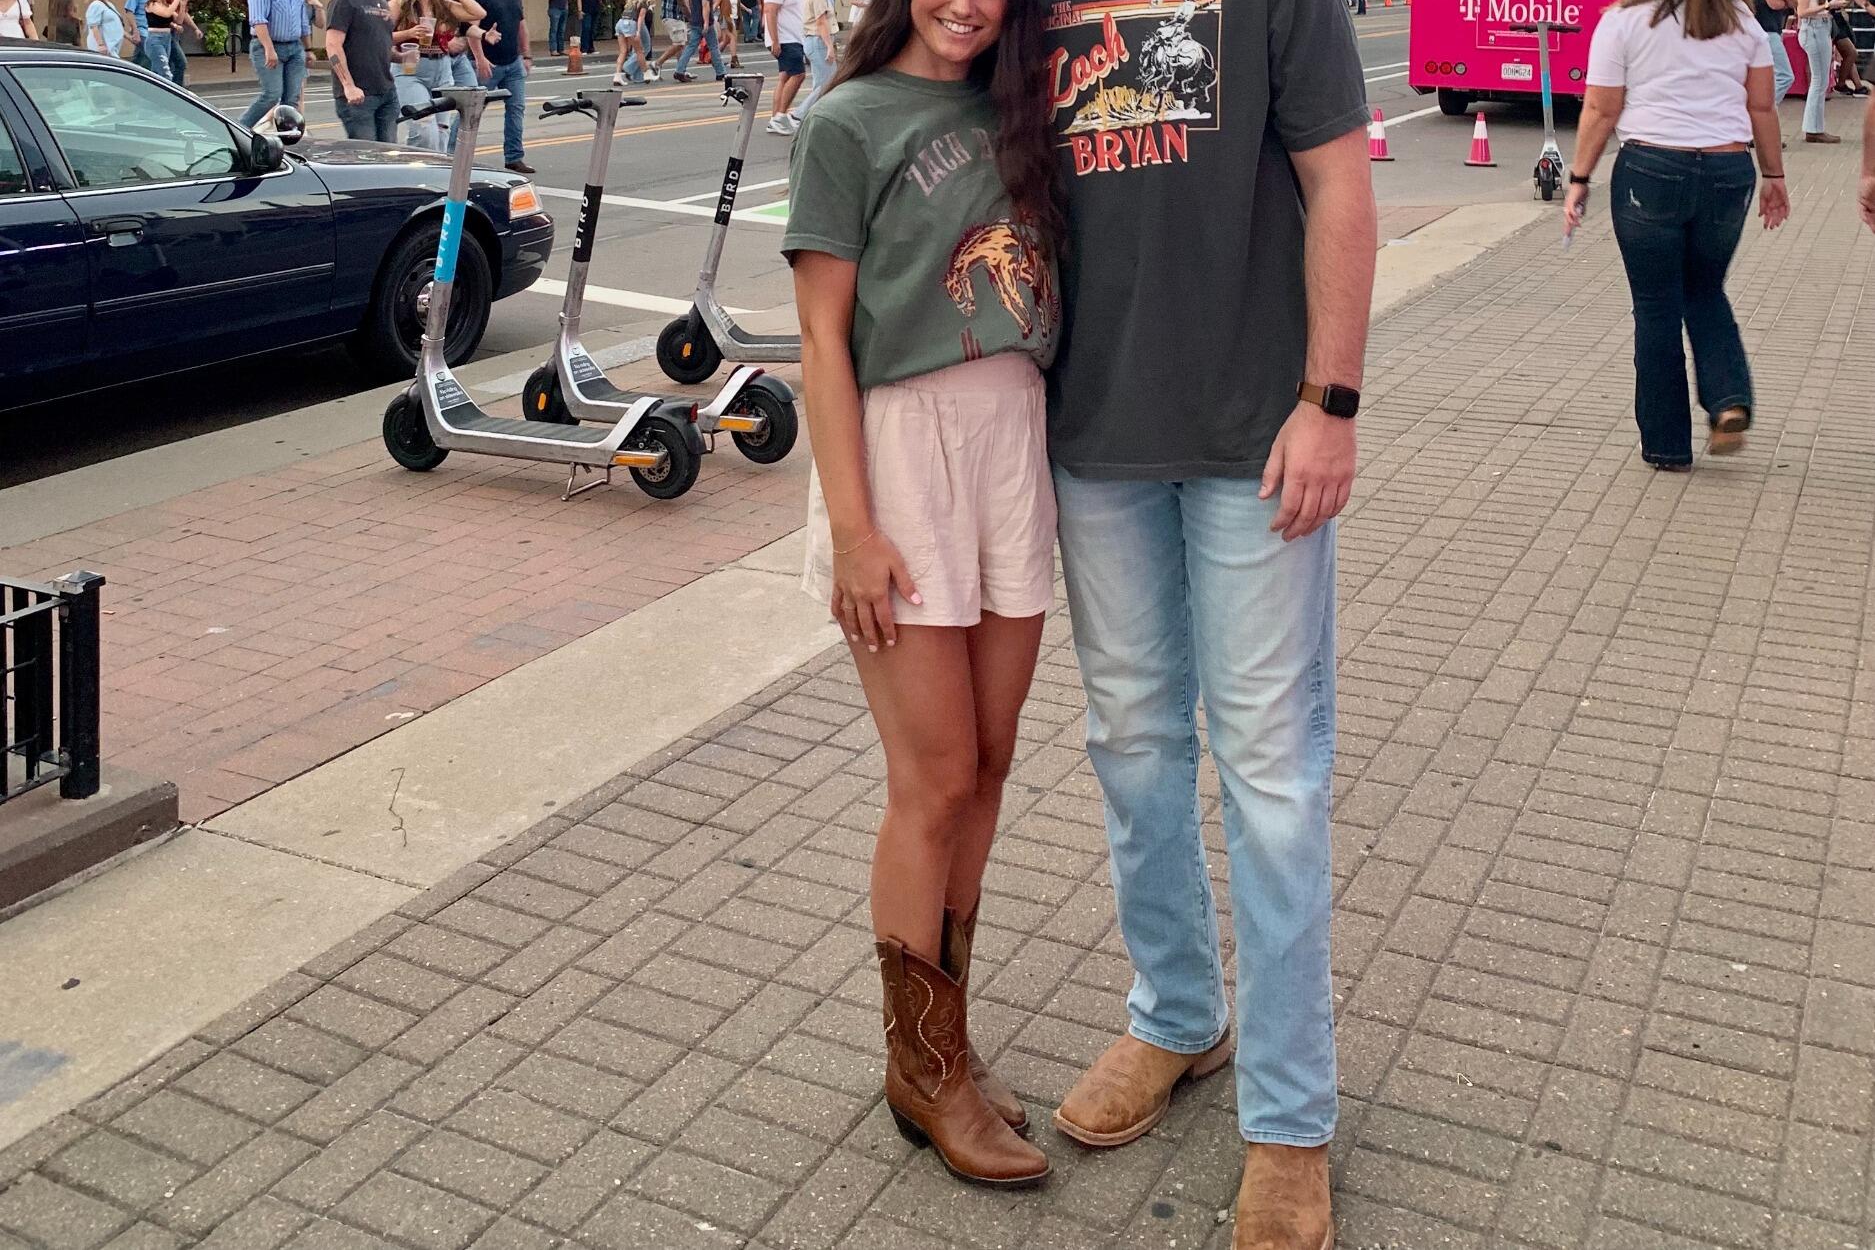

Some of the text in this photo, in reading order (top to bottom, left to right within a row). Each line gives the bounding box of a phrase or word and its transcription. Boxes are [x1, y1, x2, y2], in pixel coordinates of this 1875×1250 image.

[1051, 0, 1072, 15] THE
[905, 131, 973, 197] ZACH
[1070, 123, 1188, 176] BRYAN
[721, 170, 739, 213] BIRD
[436, 212, 451, 268] BIRD
[575, 196, 589, 249] BIRD
